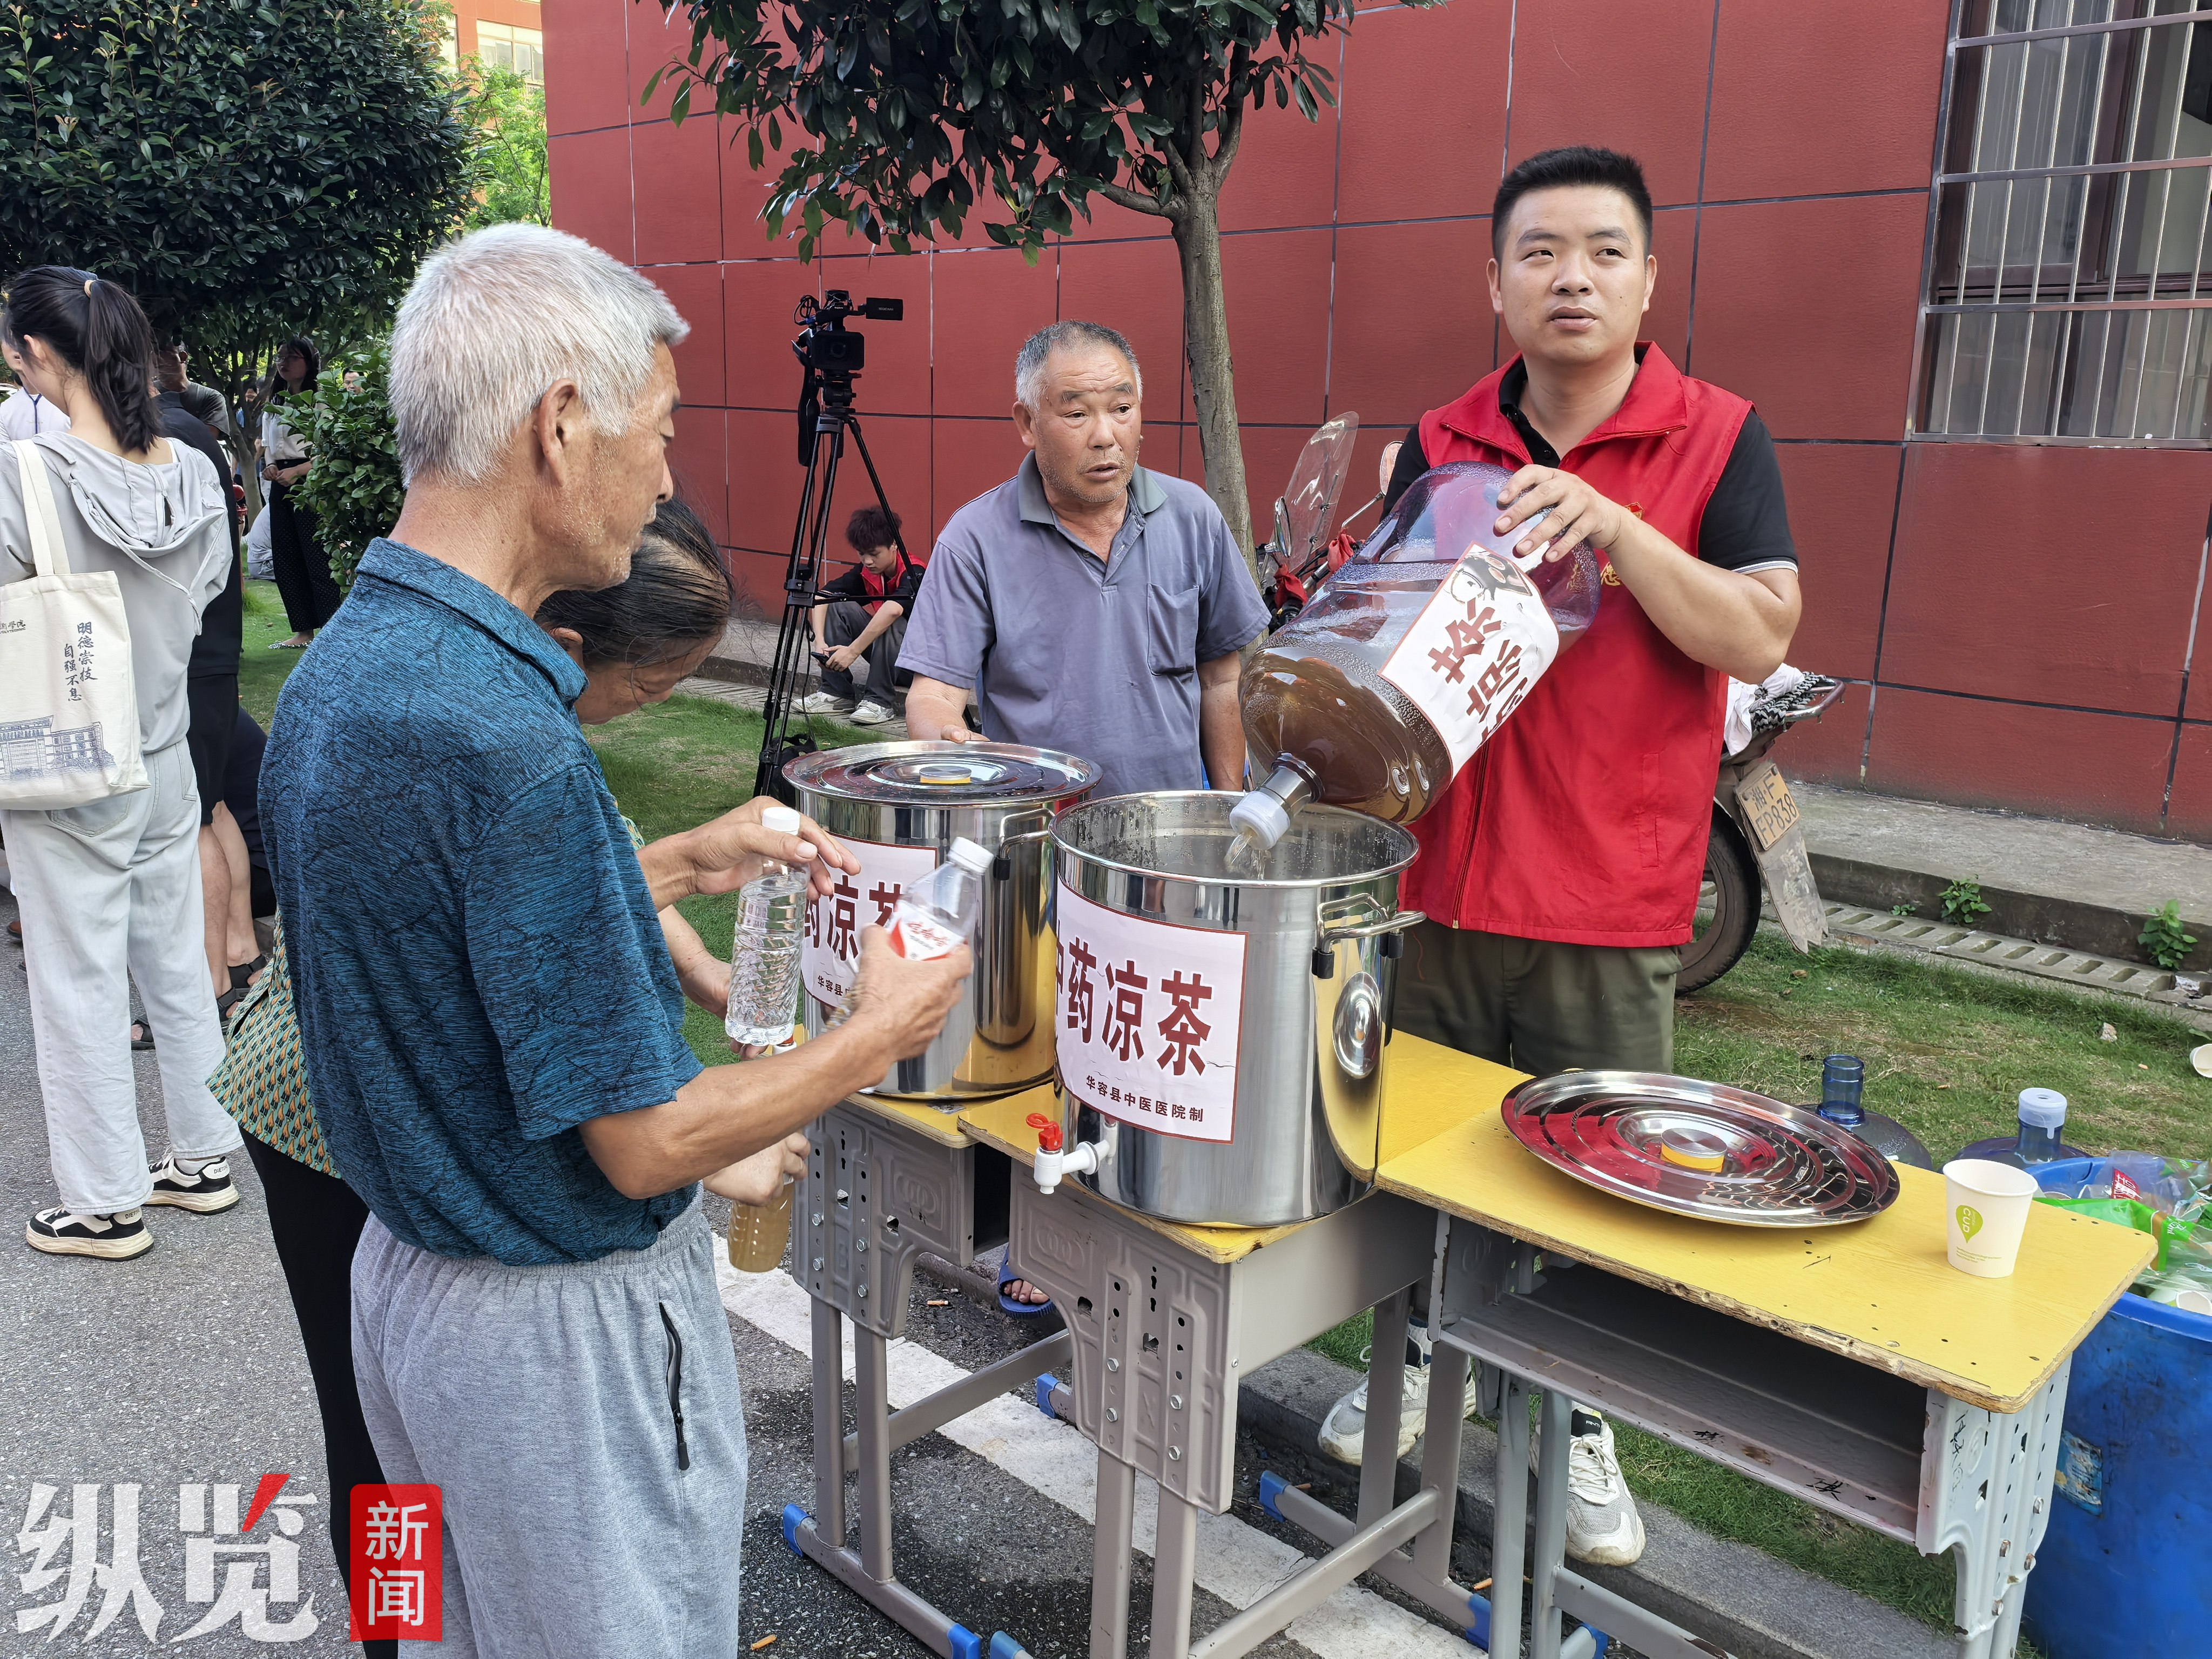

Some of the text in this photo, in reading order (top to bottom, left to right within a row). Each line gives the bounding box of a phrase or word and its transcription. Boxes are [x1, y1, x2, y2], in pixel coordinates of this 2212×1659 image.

[64, 643, 82, 702] 自强不息
[77, 622, 98, 682] 明德崇技
[1755, 793, 1797, 845] FP838
[817, 975, 851, 997] 华容县
[1086, 1075, 1204, 1122] 华容县中医医院制
[1962, 1208, 1971, 1233] CUP
